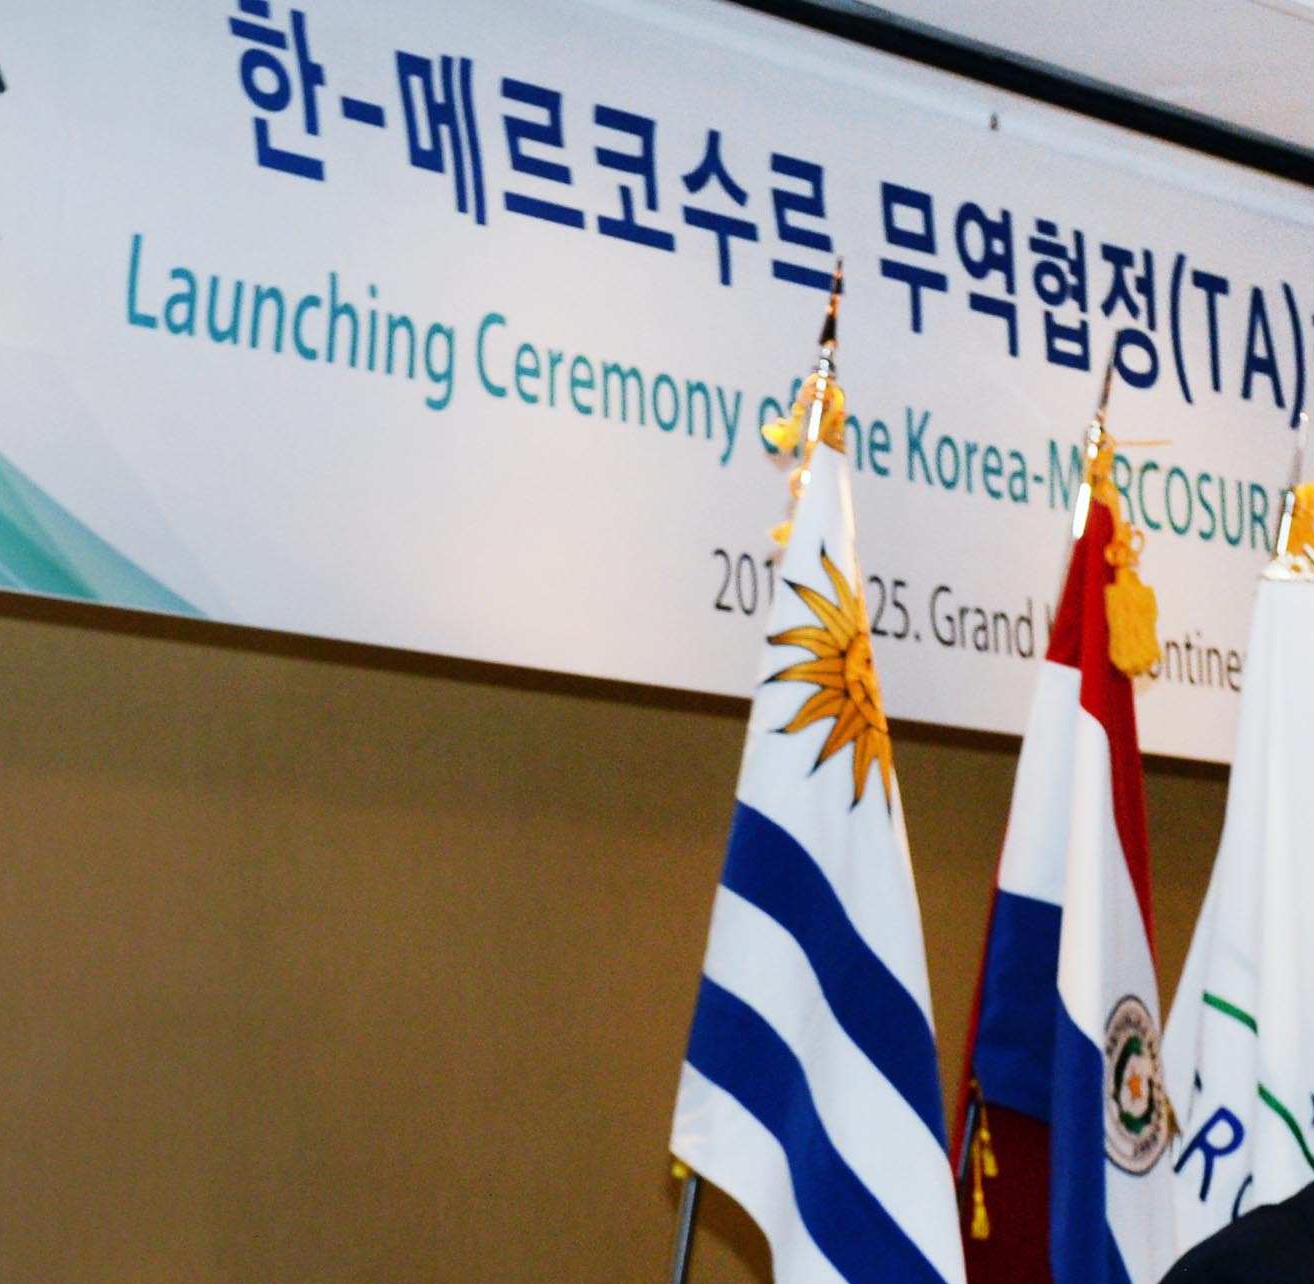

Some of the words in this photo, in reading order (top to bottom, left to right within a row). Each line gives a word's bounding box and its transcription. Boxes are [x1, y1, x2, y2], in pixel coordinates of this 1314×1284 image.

[228, 0, 843, 292] 한-메르코수르
[125, 234, 456, 411] Launching
[476, 312, 742, 466] Ceremony
[845, 414, 892, 477] he
[905, 407, 1276, 553] Korea-MRCOSUR
[930, 584, 1034, 658] Grand
